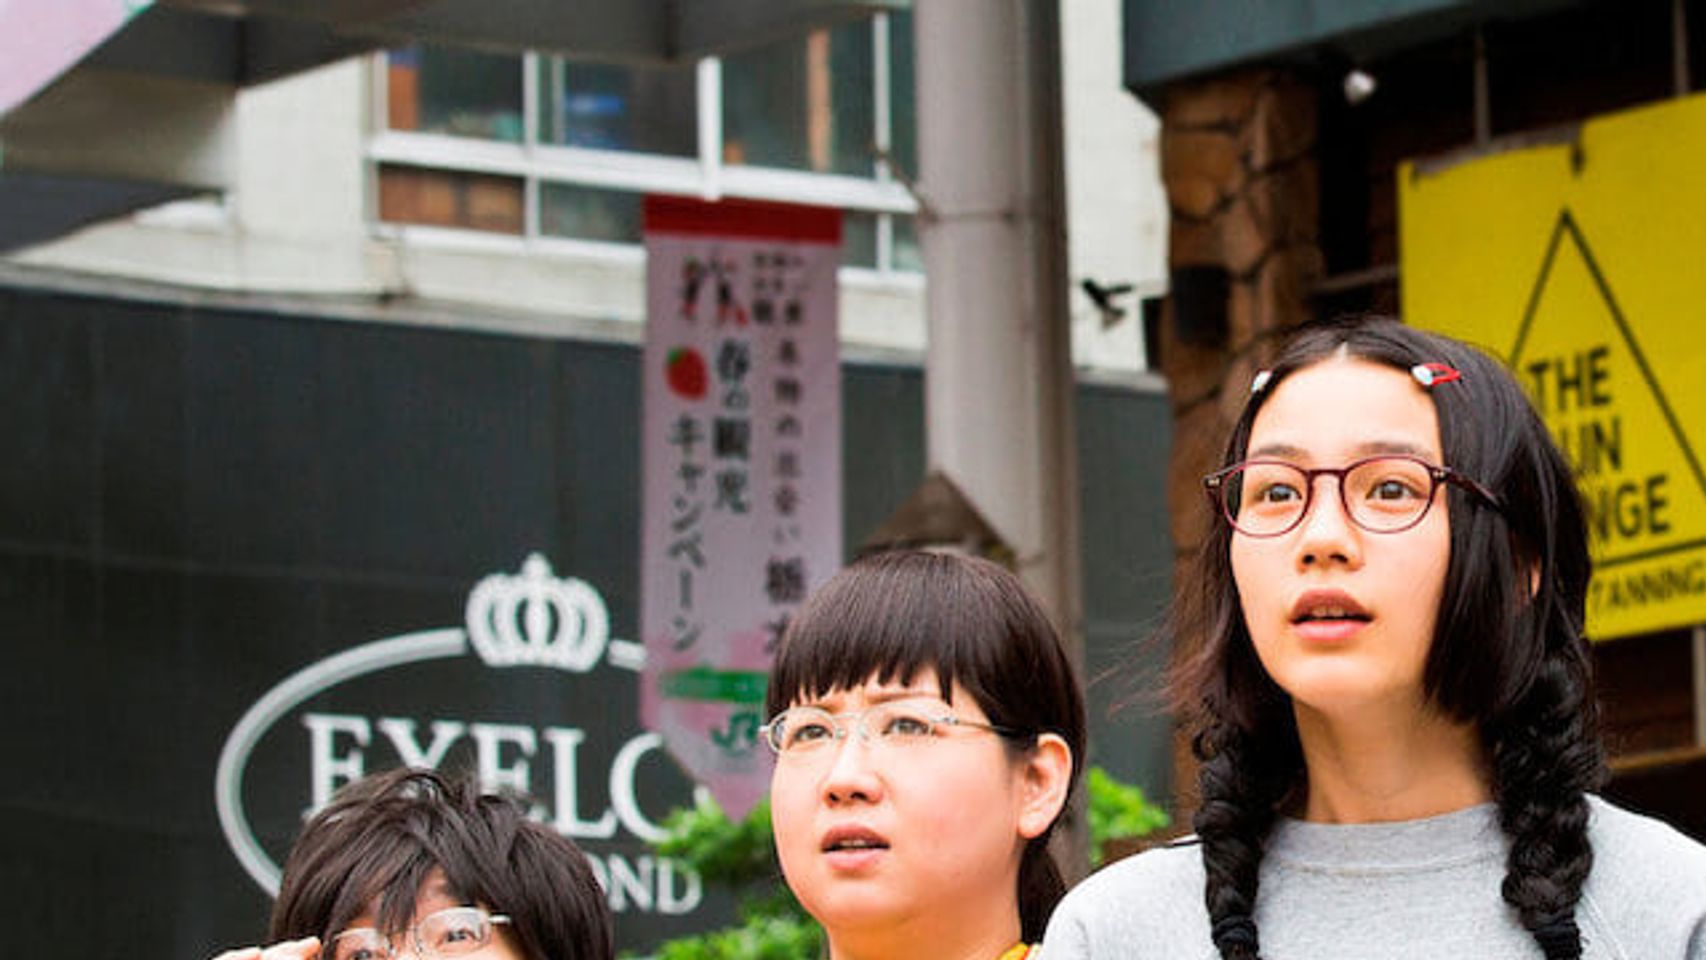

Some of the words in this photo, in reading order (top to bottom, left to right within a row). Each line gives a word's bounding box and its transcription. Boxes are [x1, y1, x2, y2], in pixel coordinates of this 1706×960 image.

[713, 337, 751, 515] 春の観光
[1527, 345, 1612, 414] THE
[666, 413, 707, 652] キャンペーン
